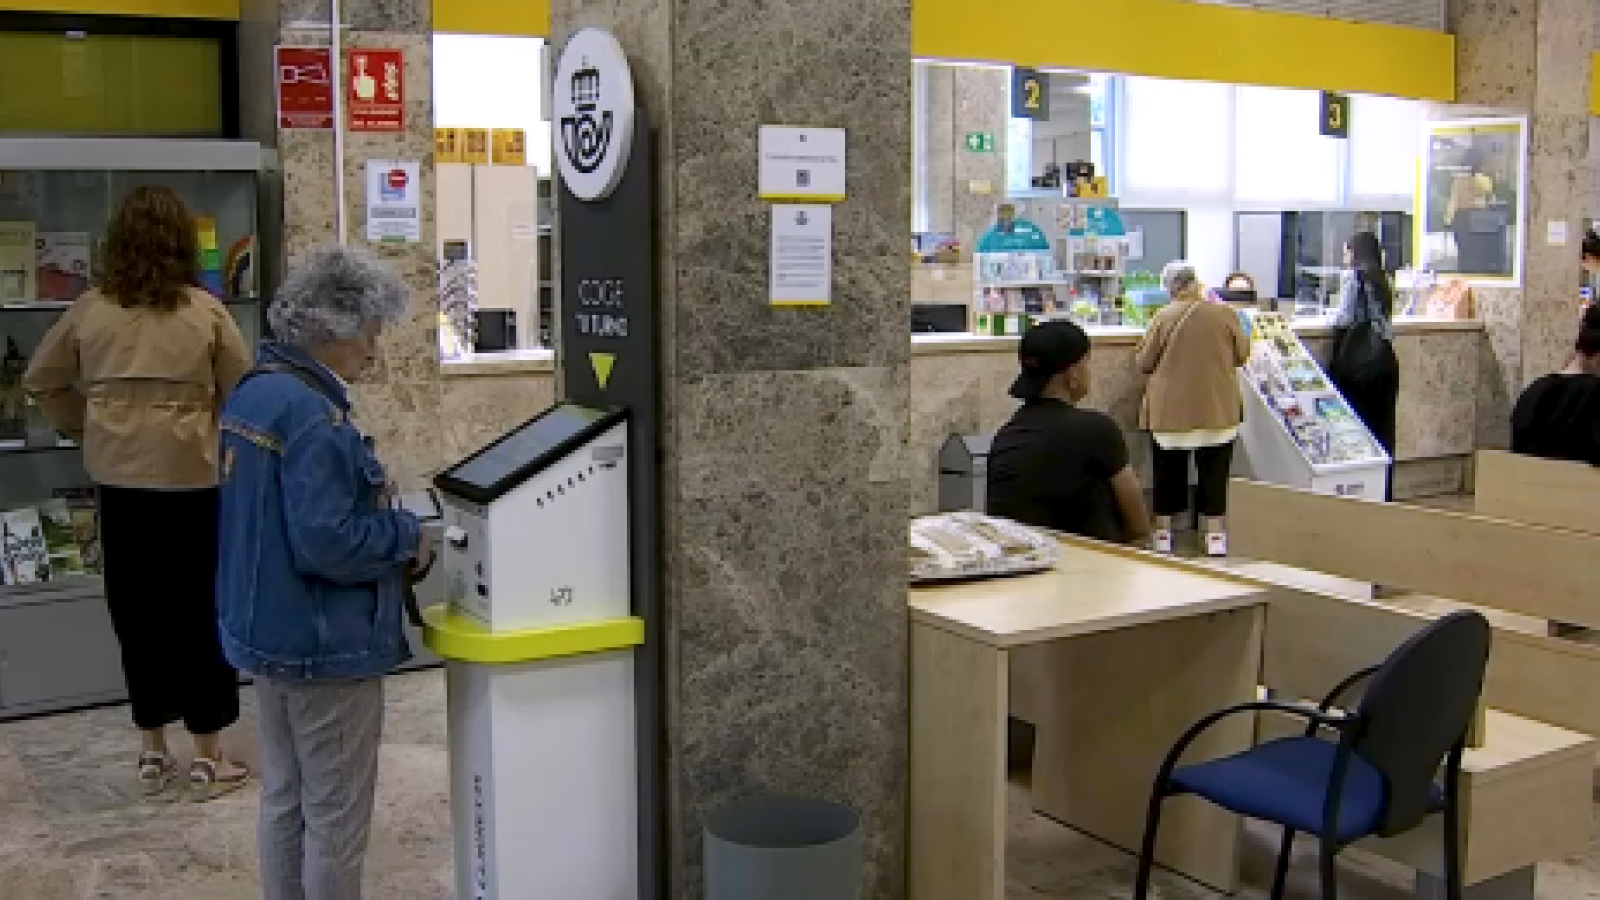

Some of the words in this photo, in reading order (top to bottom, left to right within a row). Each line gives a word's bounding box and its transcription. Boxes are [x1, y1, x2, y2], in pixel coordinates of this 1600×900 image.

[1024, 79, 1040, 108] 2
[1329, 103, 1341, 129] 3
[578, 280, 624, 307] COGE
